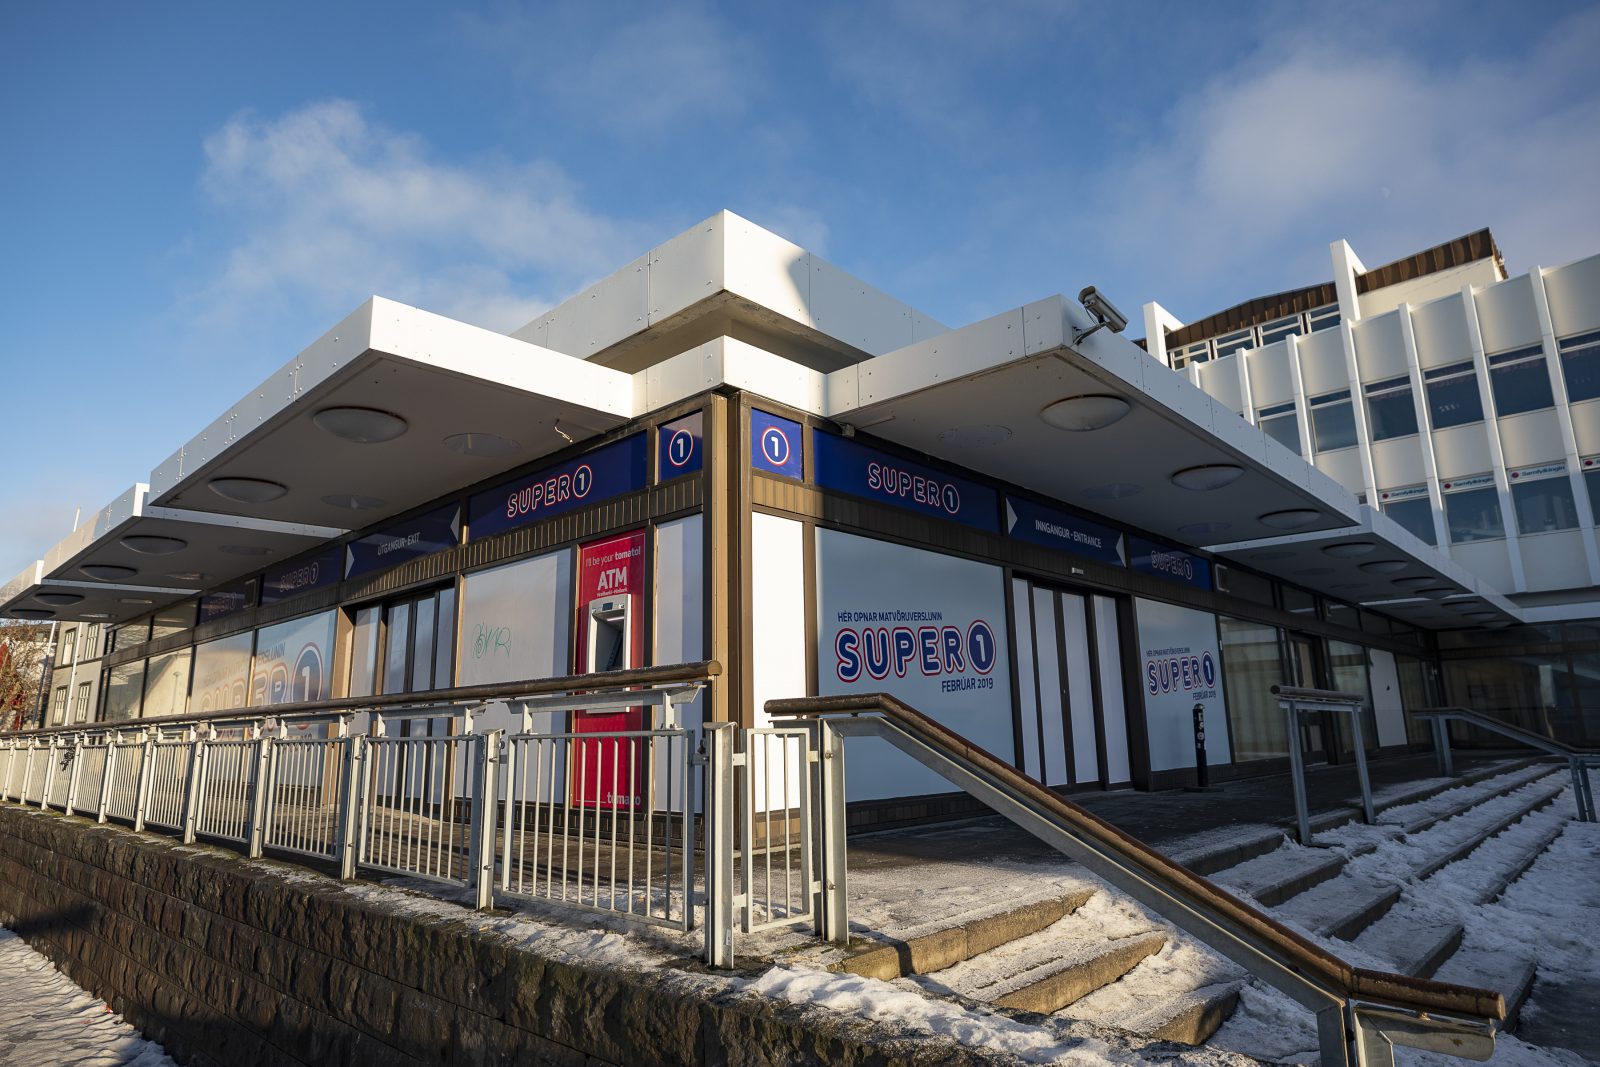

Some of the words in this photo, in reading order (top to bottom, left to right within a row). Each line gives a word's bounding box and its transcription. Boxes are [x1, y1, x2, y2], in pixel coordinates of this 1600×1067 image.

[868, 462, 940, 507] SUPER
[506, 473, 571, 518] SUPER
[407, 532, 421, 546] EXIT
[1073, 531, 1102, 548] ENTRANCE
[592, 556, 599, 566] be
[600, 554, 614, 566] your
[614, 546, 641, 560] tomato!
[597, 566, 627, 591] ATM
[837, 611, 853, 622] HÉR
[854, 611, 877, 622] OPNAR
[878, 610, 943, 622] MATVÖRUVERSLUNIN
[835, 626, 965, 683] SUPER
[941, 677, 976, 693] FEBRÚAR
[977, 677, 994, 689] 2019
[1147, 656, 1203, 696] SUPER
[607, 791, 641, 806] tomao
